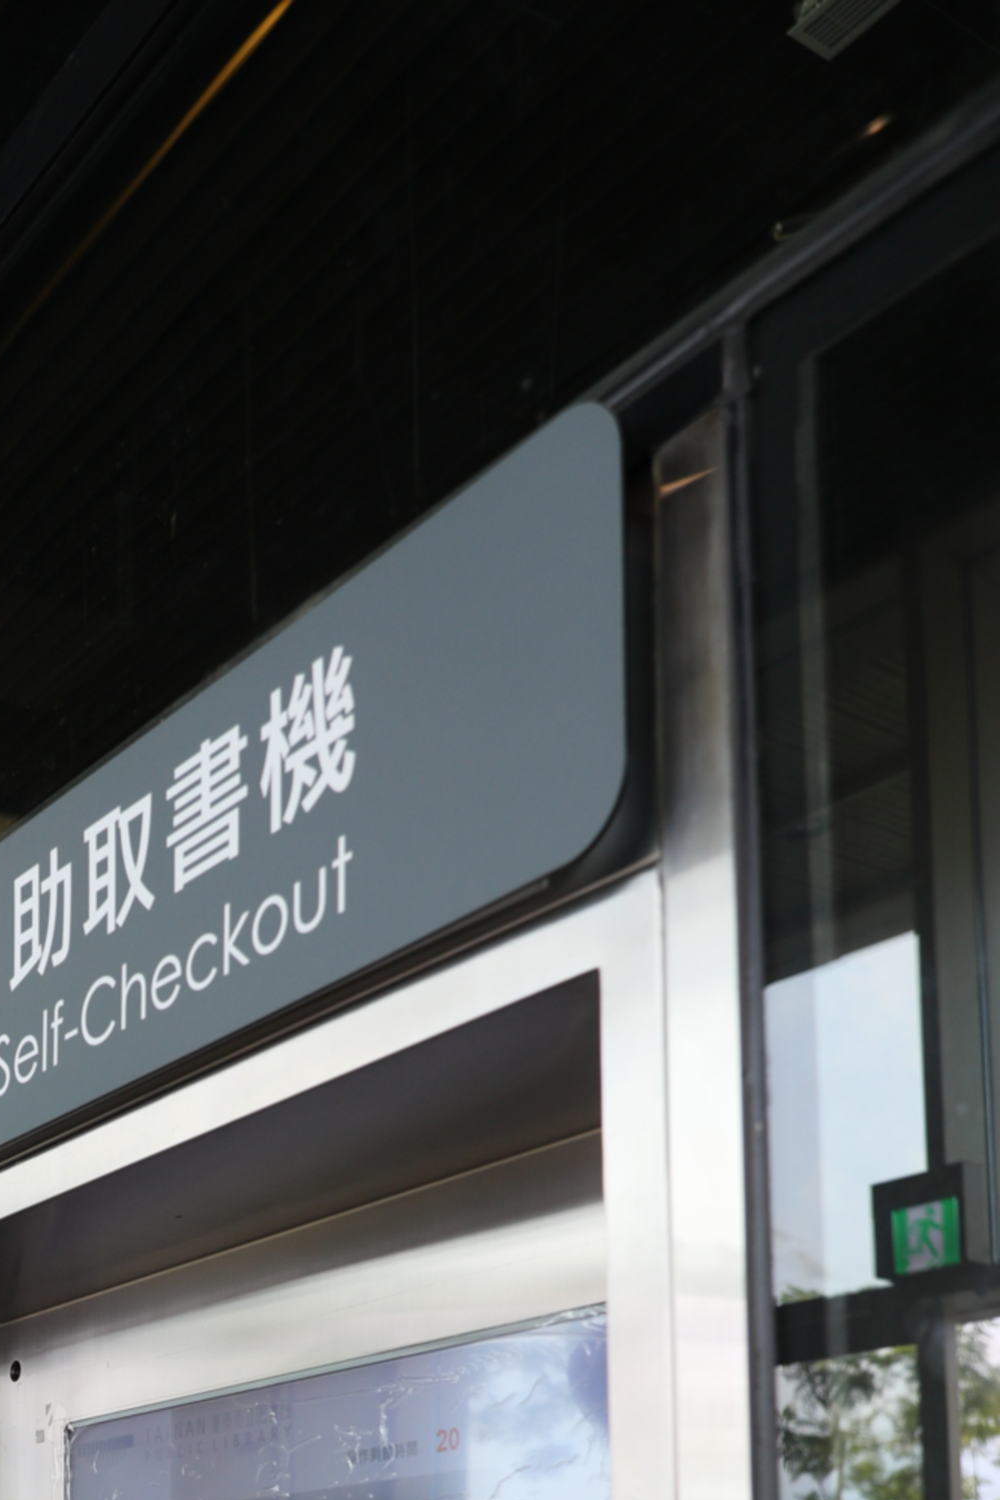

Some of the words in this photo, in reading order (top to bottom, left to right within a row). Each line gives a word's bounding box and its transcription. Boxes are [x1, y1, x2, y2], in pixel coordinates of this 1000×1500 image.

[143, 1439, 204, 1463] PUBLIC
[211, 1424, 293, 1450] LIBRARY
[144, 1417, 206, 1445] TAINAN
[436, 1427, 460, 1453] 20
